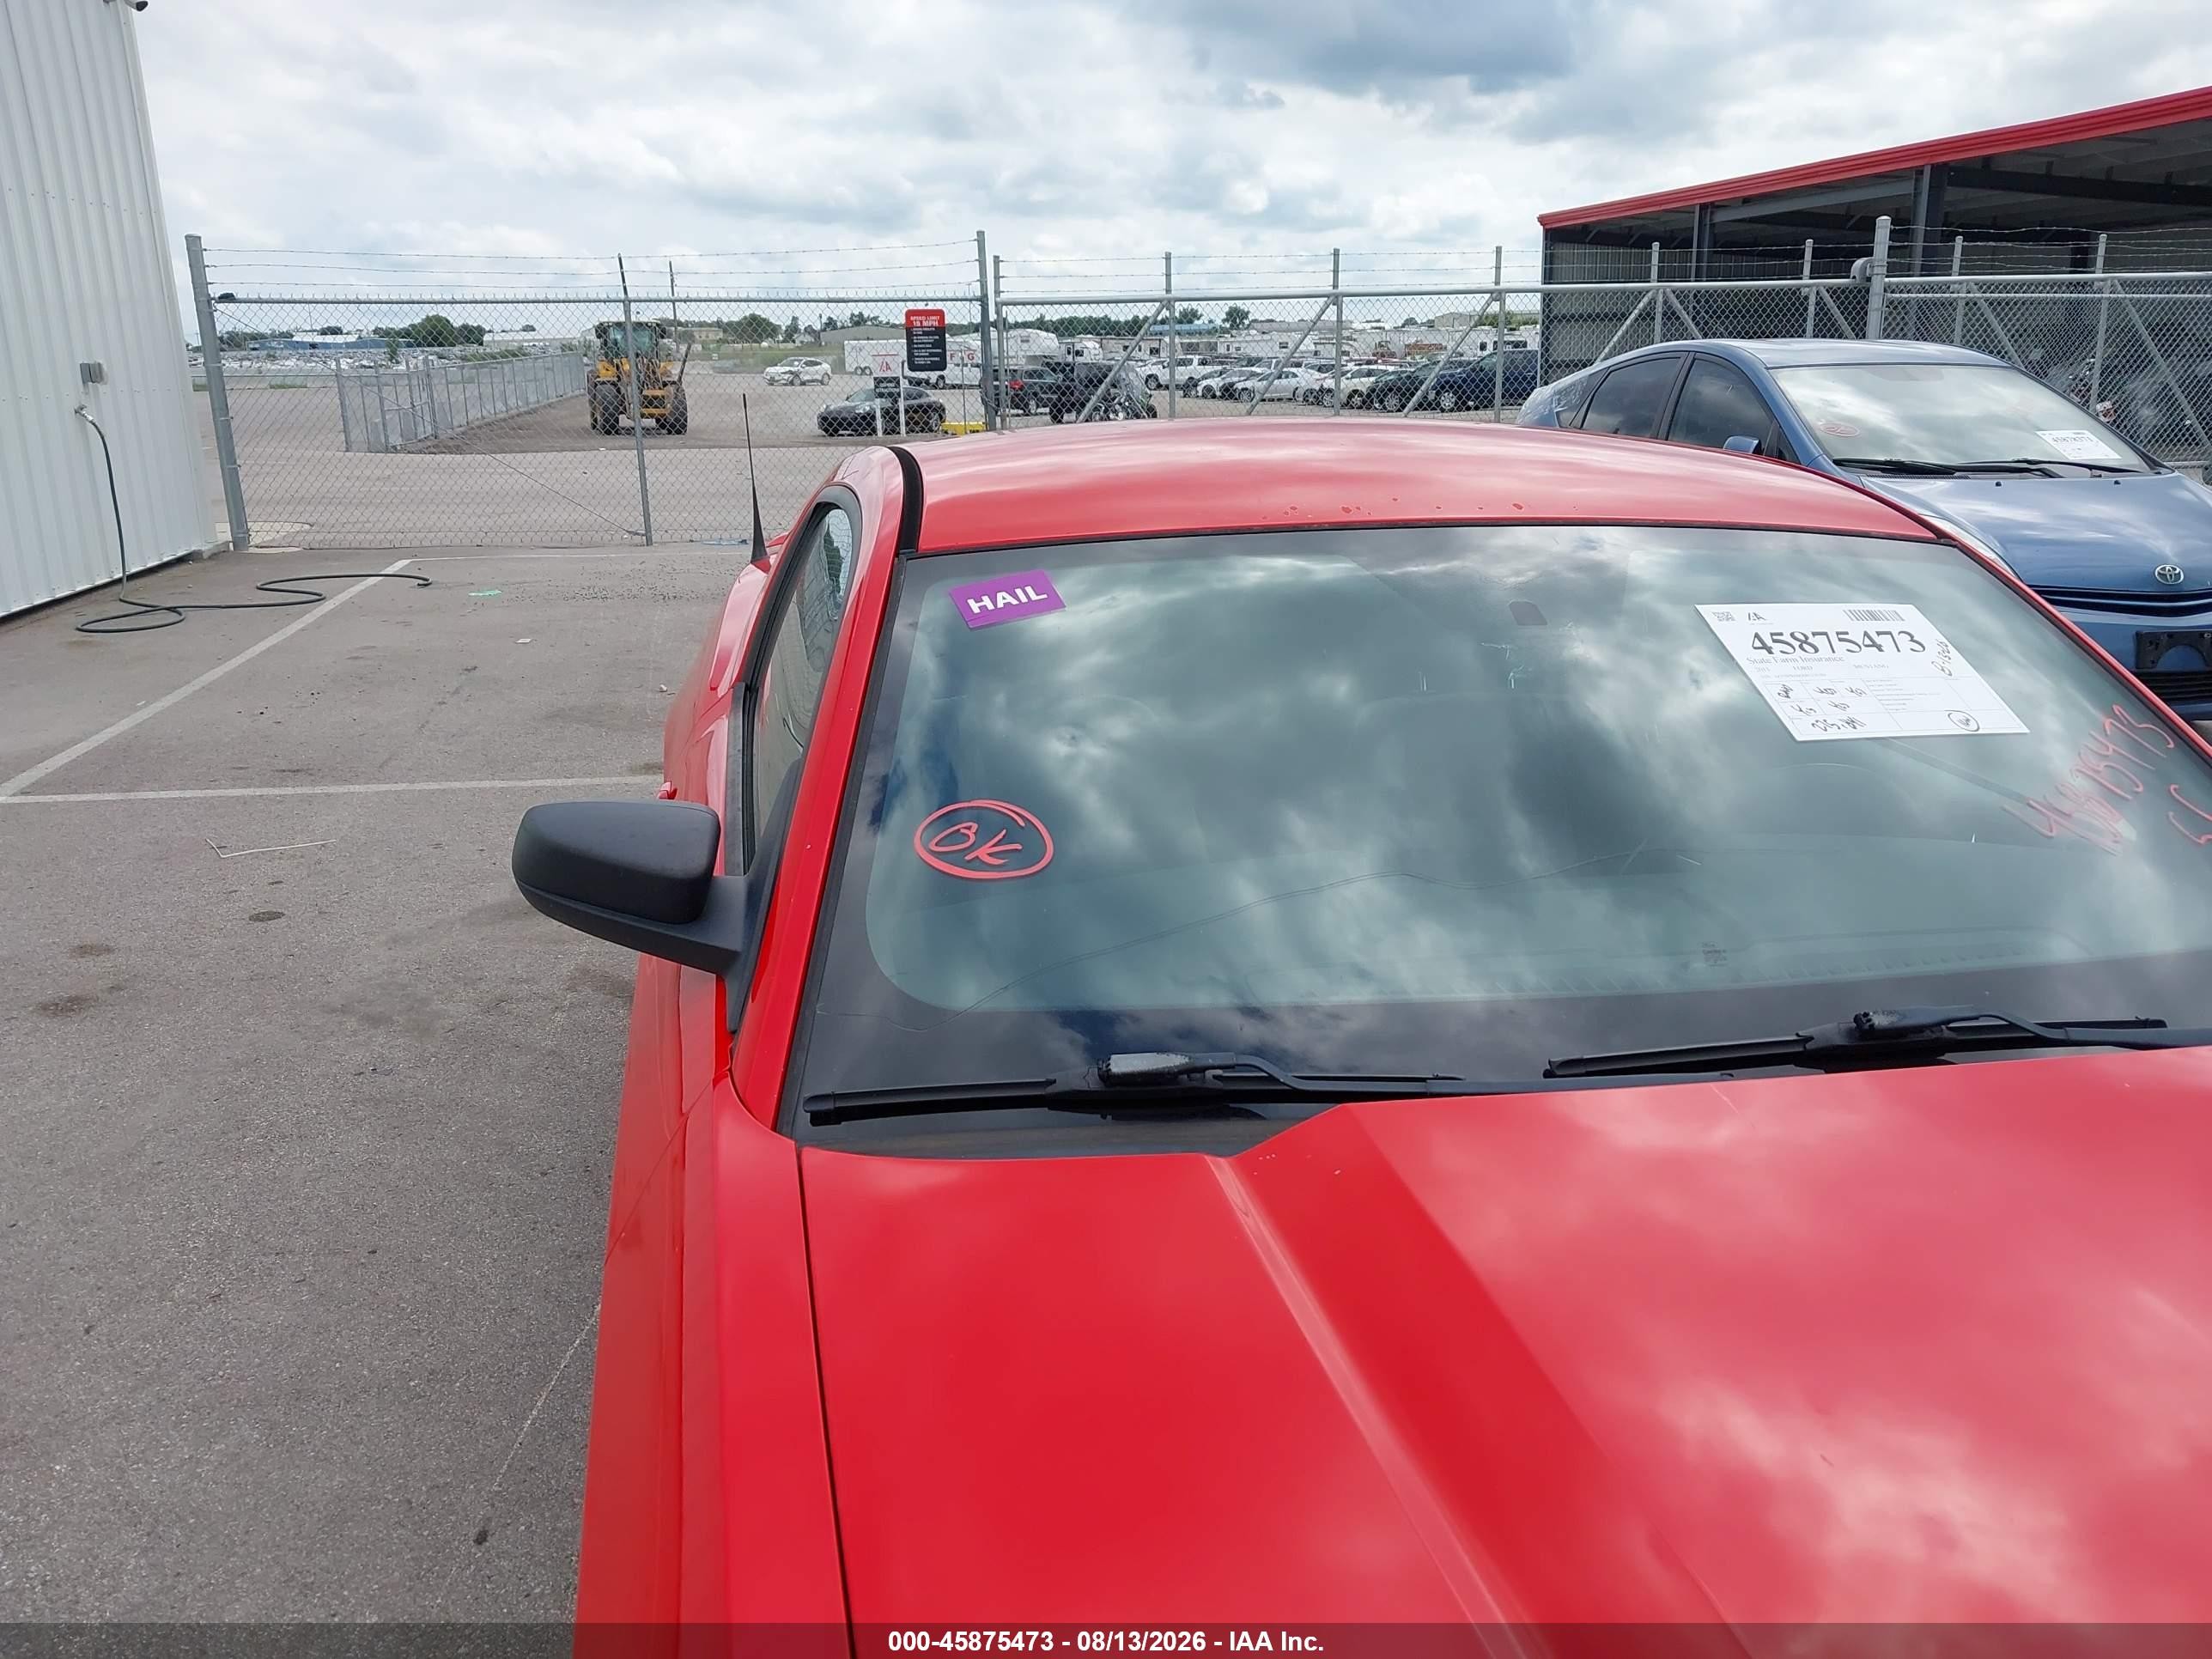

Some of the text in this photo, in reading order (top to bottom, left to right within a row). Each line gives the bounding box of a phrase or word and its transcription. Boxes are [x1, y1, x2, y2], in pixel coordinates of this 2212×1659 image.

[967, 586, 1048, 613] HAIL
[1752, 630, 1926, 654] 45875473
[1747, 657, 1772, 665] State
[929, 822, 1023, 865] OK
